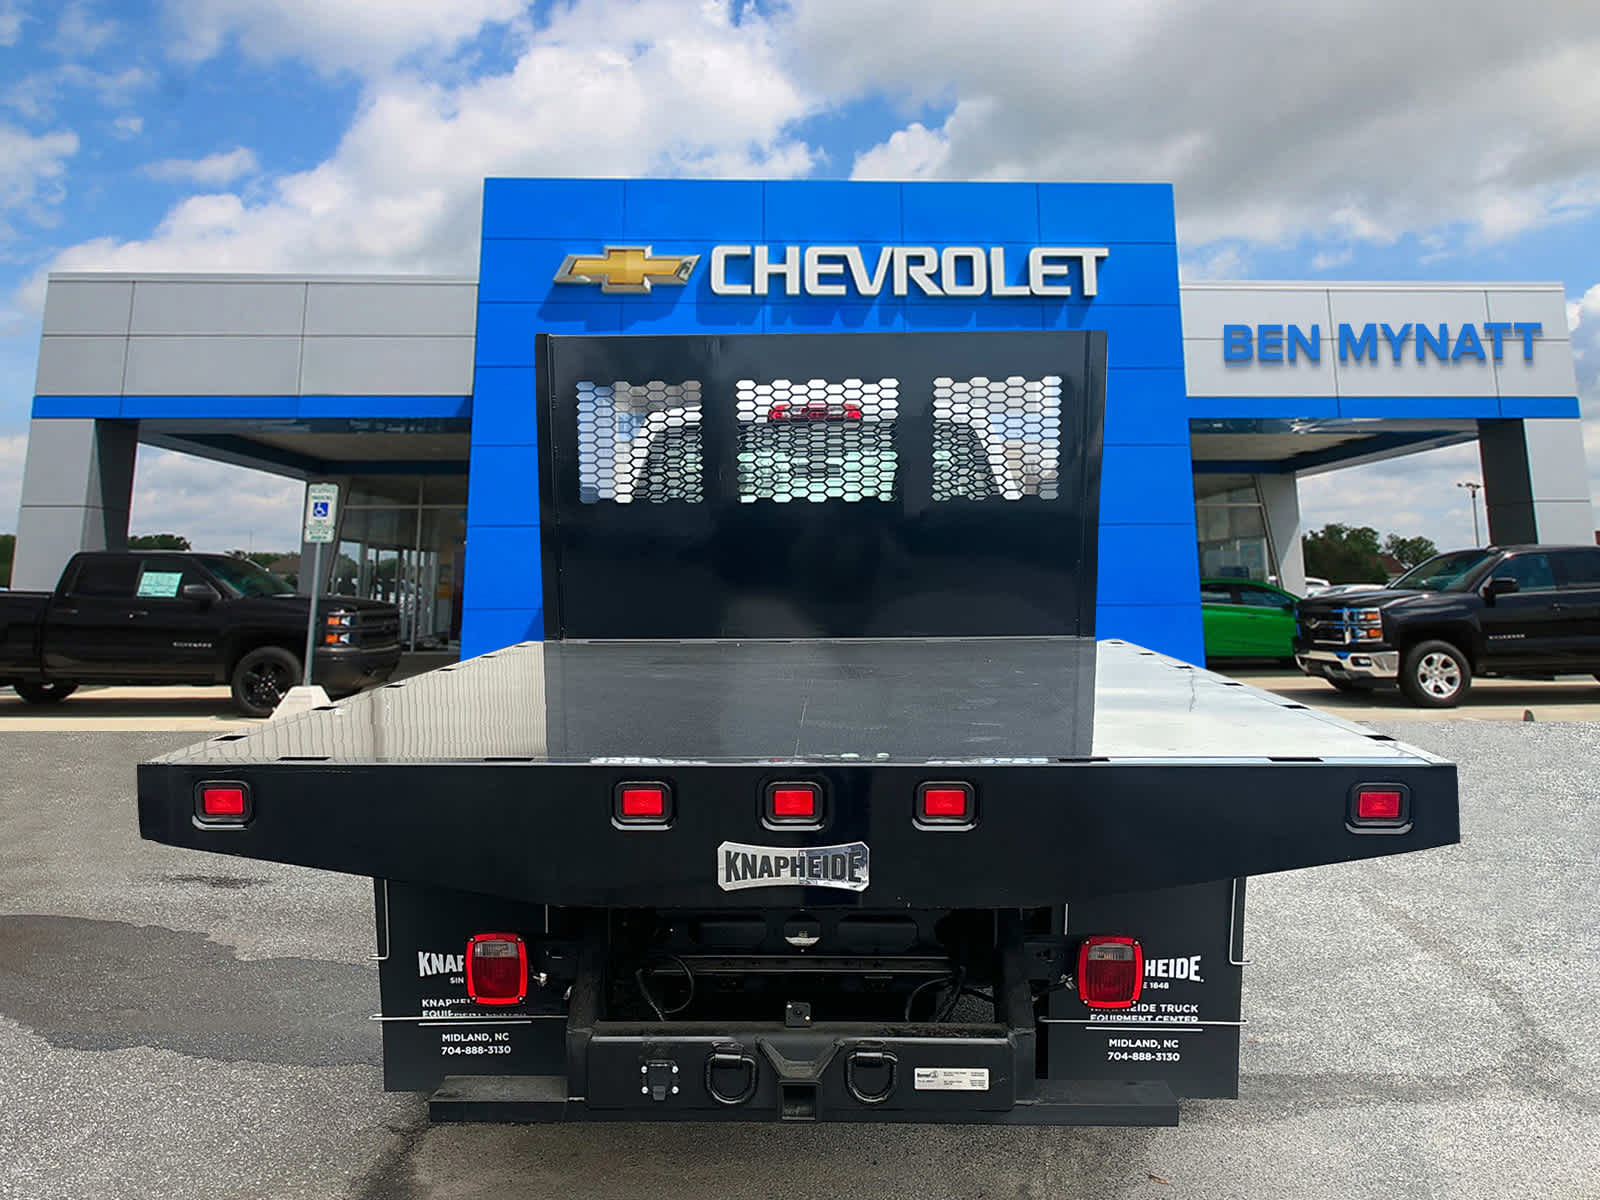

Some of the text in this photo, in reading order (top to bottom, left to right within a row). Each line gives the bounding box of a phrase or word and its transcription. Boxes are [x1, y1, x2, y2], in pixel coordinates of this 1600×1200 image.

[710, 245, 1109, 297] CHEVROLET
[1223, 322, 1542, 364] BEN MYNATT
[725, 850, 862, 883] KNAPHEIDE
[1160, 1003, 1199, 1013] TRUCK
[442, 1032, 510, 1042] MIDLAND, NC
[1109, 1039, 1179, 1049] MIDLAND, NC
[441, 1045, 511, 1055] 704-888-3130
[1107, 1052, 1180, 1062] 704-888-3130
